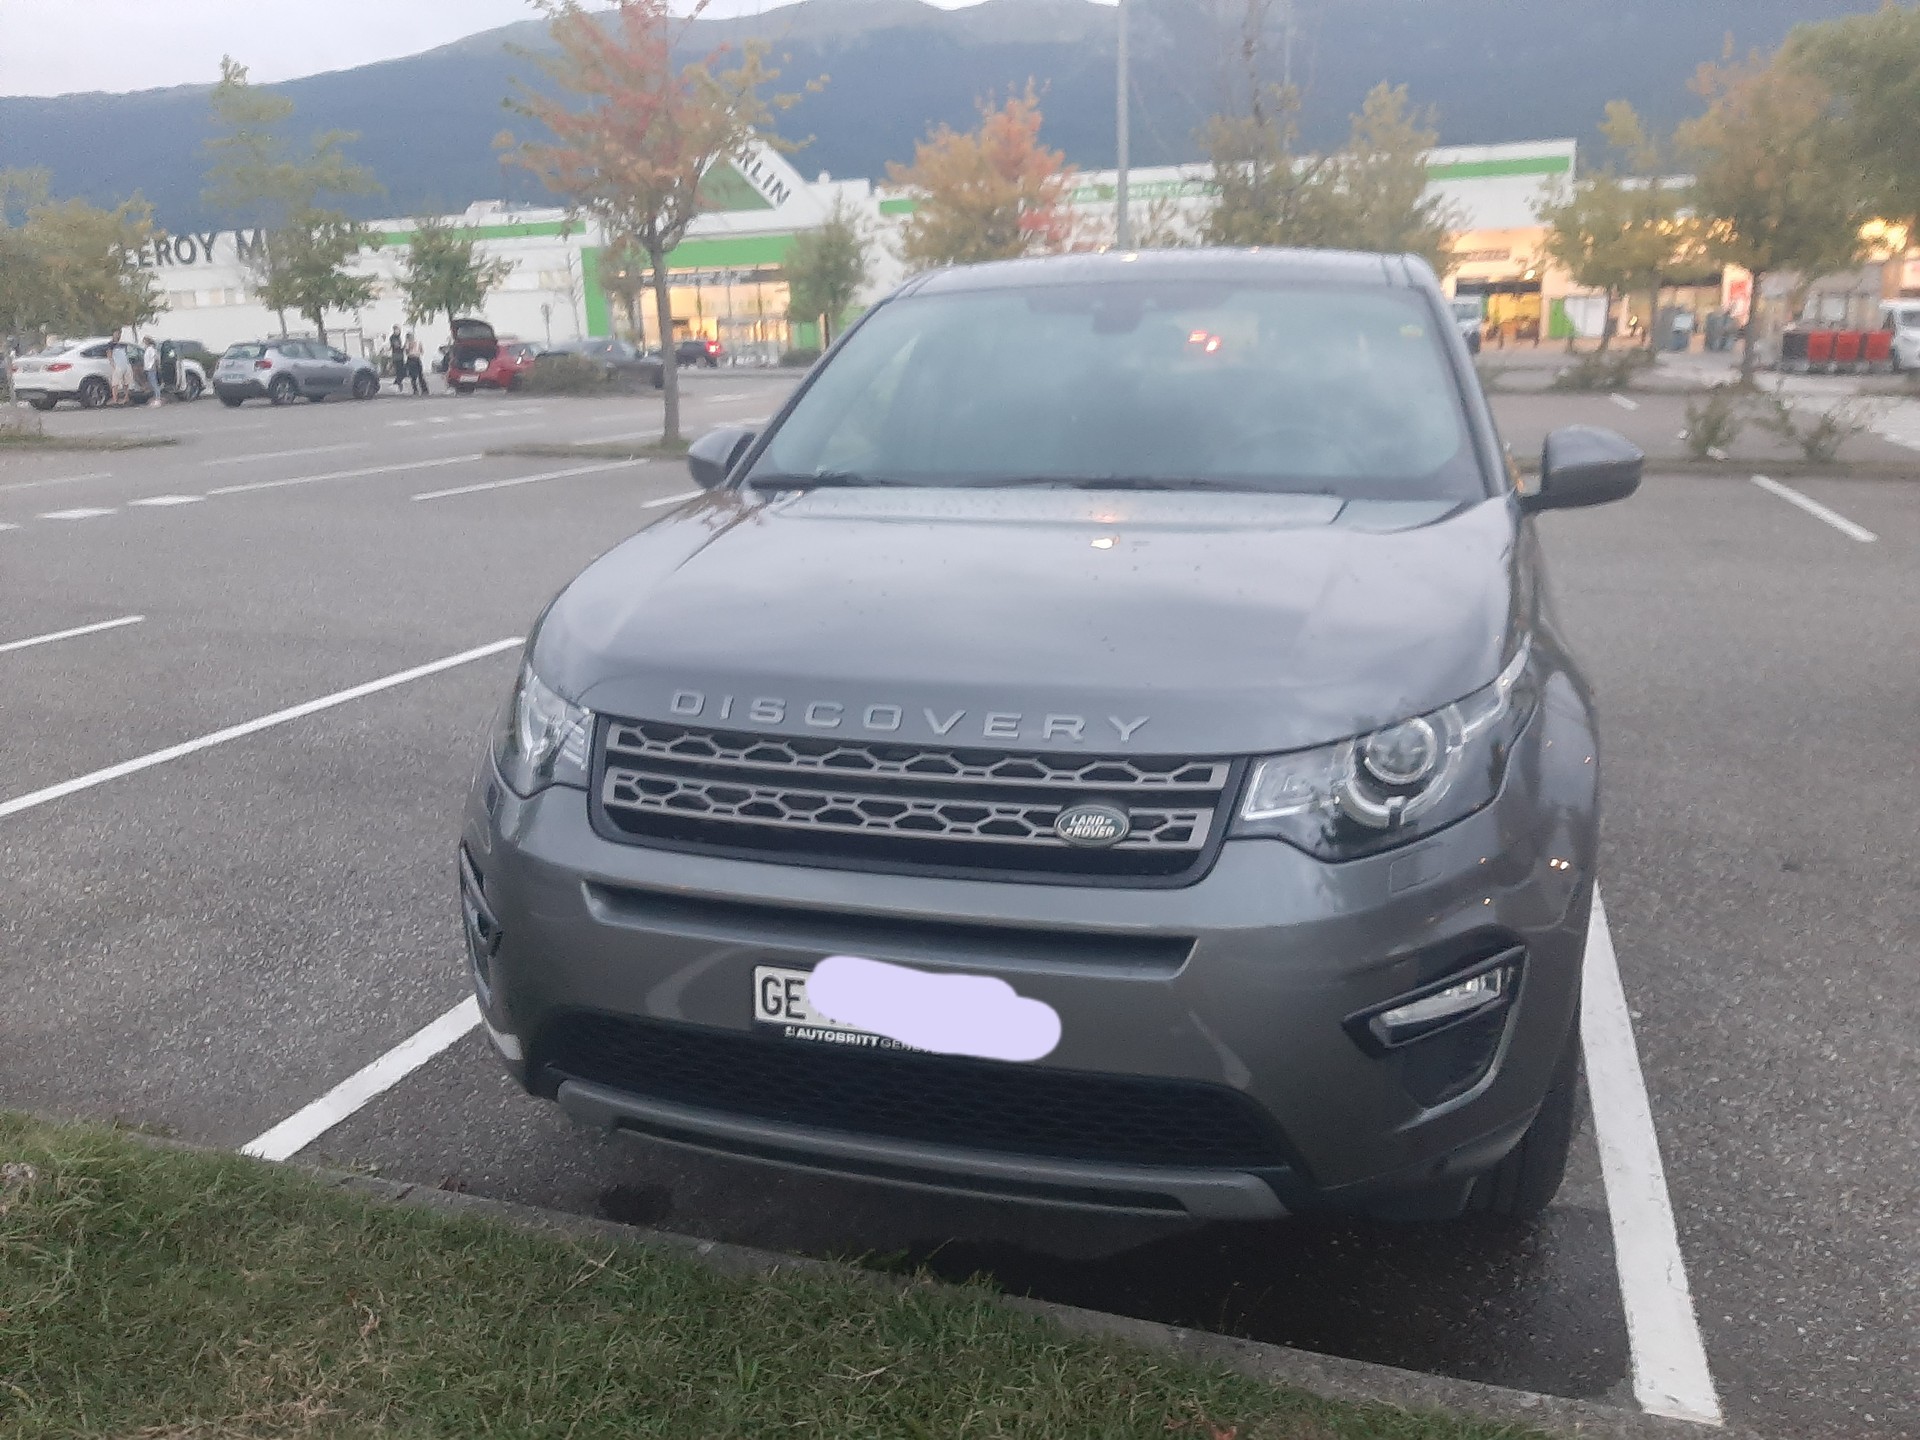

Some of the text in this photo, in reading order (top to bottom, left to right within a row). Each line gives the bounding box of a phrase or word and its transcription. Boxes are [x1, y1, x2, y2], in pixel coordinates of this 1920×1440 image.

[736, 146, 791, 205] RLIN
[670, 690, 1151, 744] DISCOVERY
[1069, 814, 1105, 827] LAND
[1072, 825, 1116, 838] ROVER
[761, 974, 806, 1019] GE
